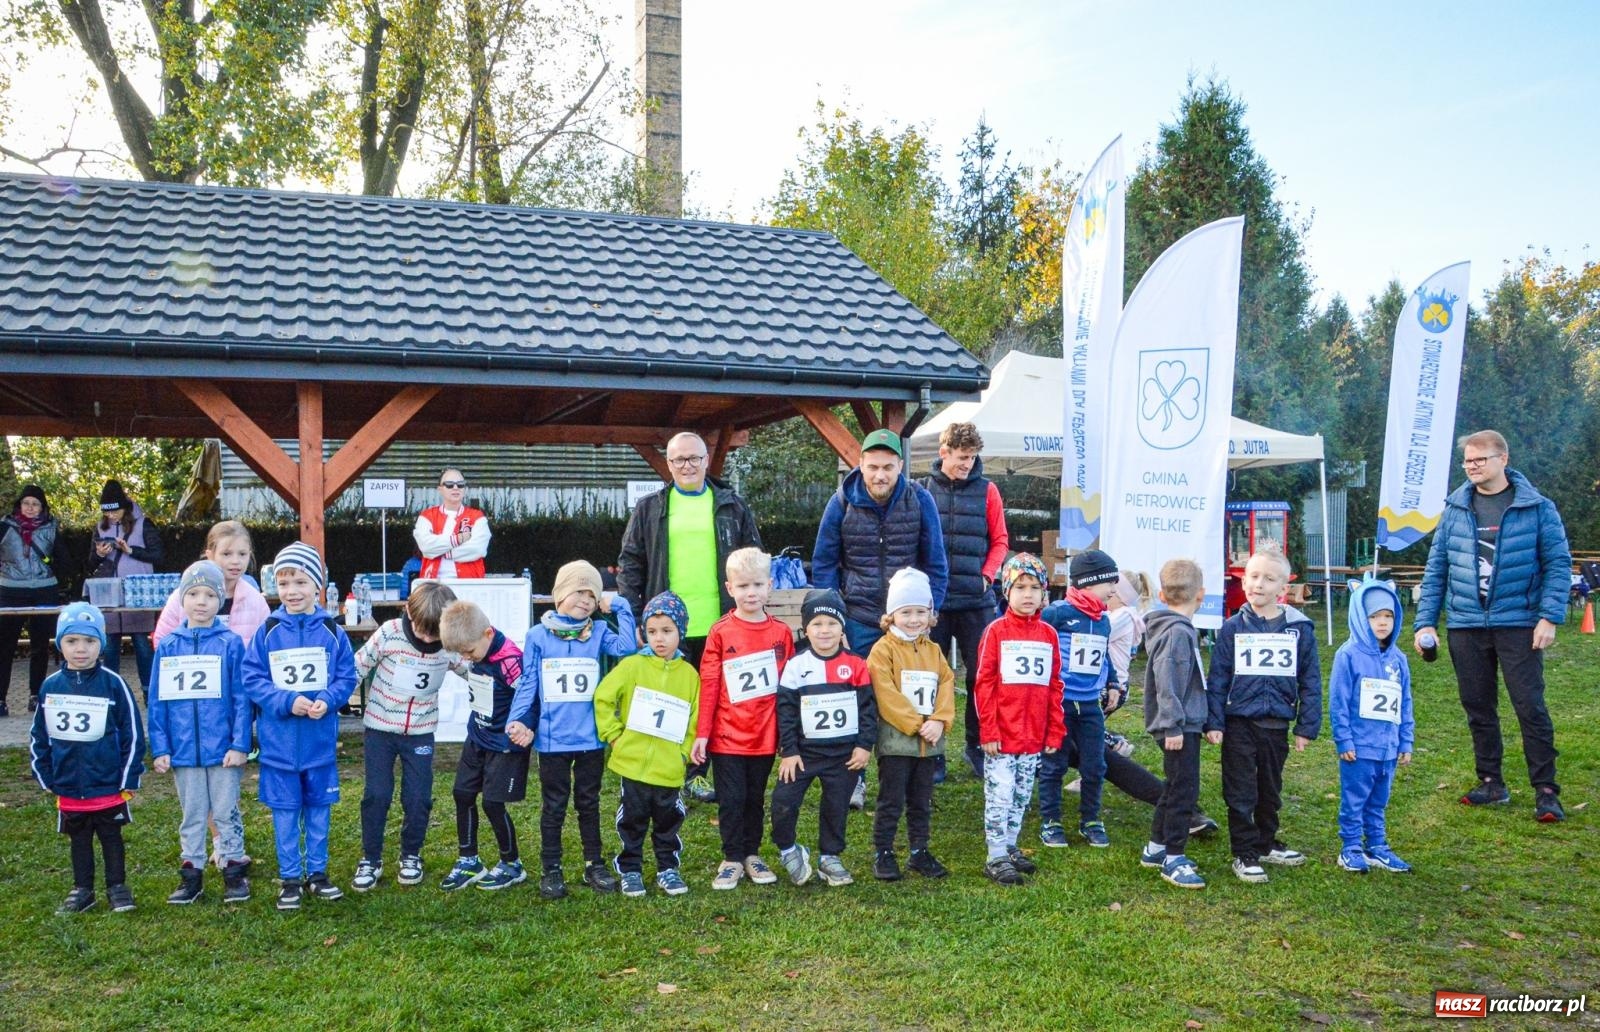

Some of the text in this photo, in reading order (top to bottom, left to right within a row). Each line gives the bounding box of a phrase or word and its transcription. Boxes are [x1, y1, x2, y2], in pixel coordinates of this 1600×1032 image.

[1400, 338, 1442, 510] STOWARZYSZENIE AKTYWNI DLA LEPSZEGO JUTRA
[1243, 440, 1270, 454] JUTRA
[370, 482, 400, 490] ZAPISY
[1142, 471, 1189, 486] GMINA
[1125, 492, 1207, 511] PIETROWICE
[1135, 516, 1192, 533] WIELKIE
[813, 606, 837, 615] JUNIOR
[1015, 656, 1044, 676] 35
[1240, 648, 1293, 668] 123
[173, 670, 207, 691] 12
[283, 663, 317, 685] 32
[415, 672, 430, 690] 3
[556, 673, 588, 694] 19
[738, 667, 770, 693] 21
[1372, 693, 1399, 716] 24
[56, 711, 91, 733] 33
[652, 709, 665, 729] 1
[814, 709, 847, 731] 29
